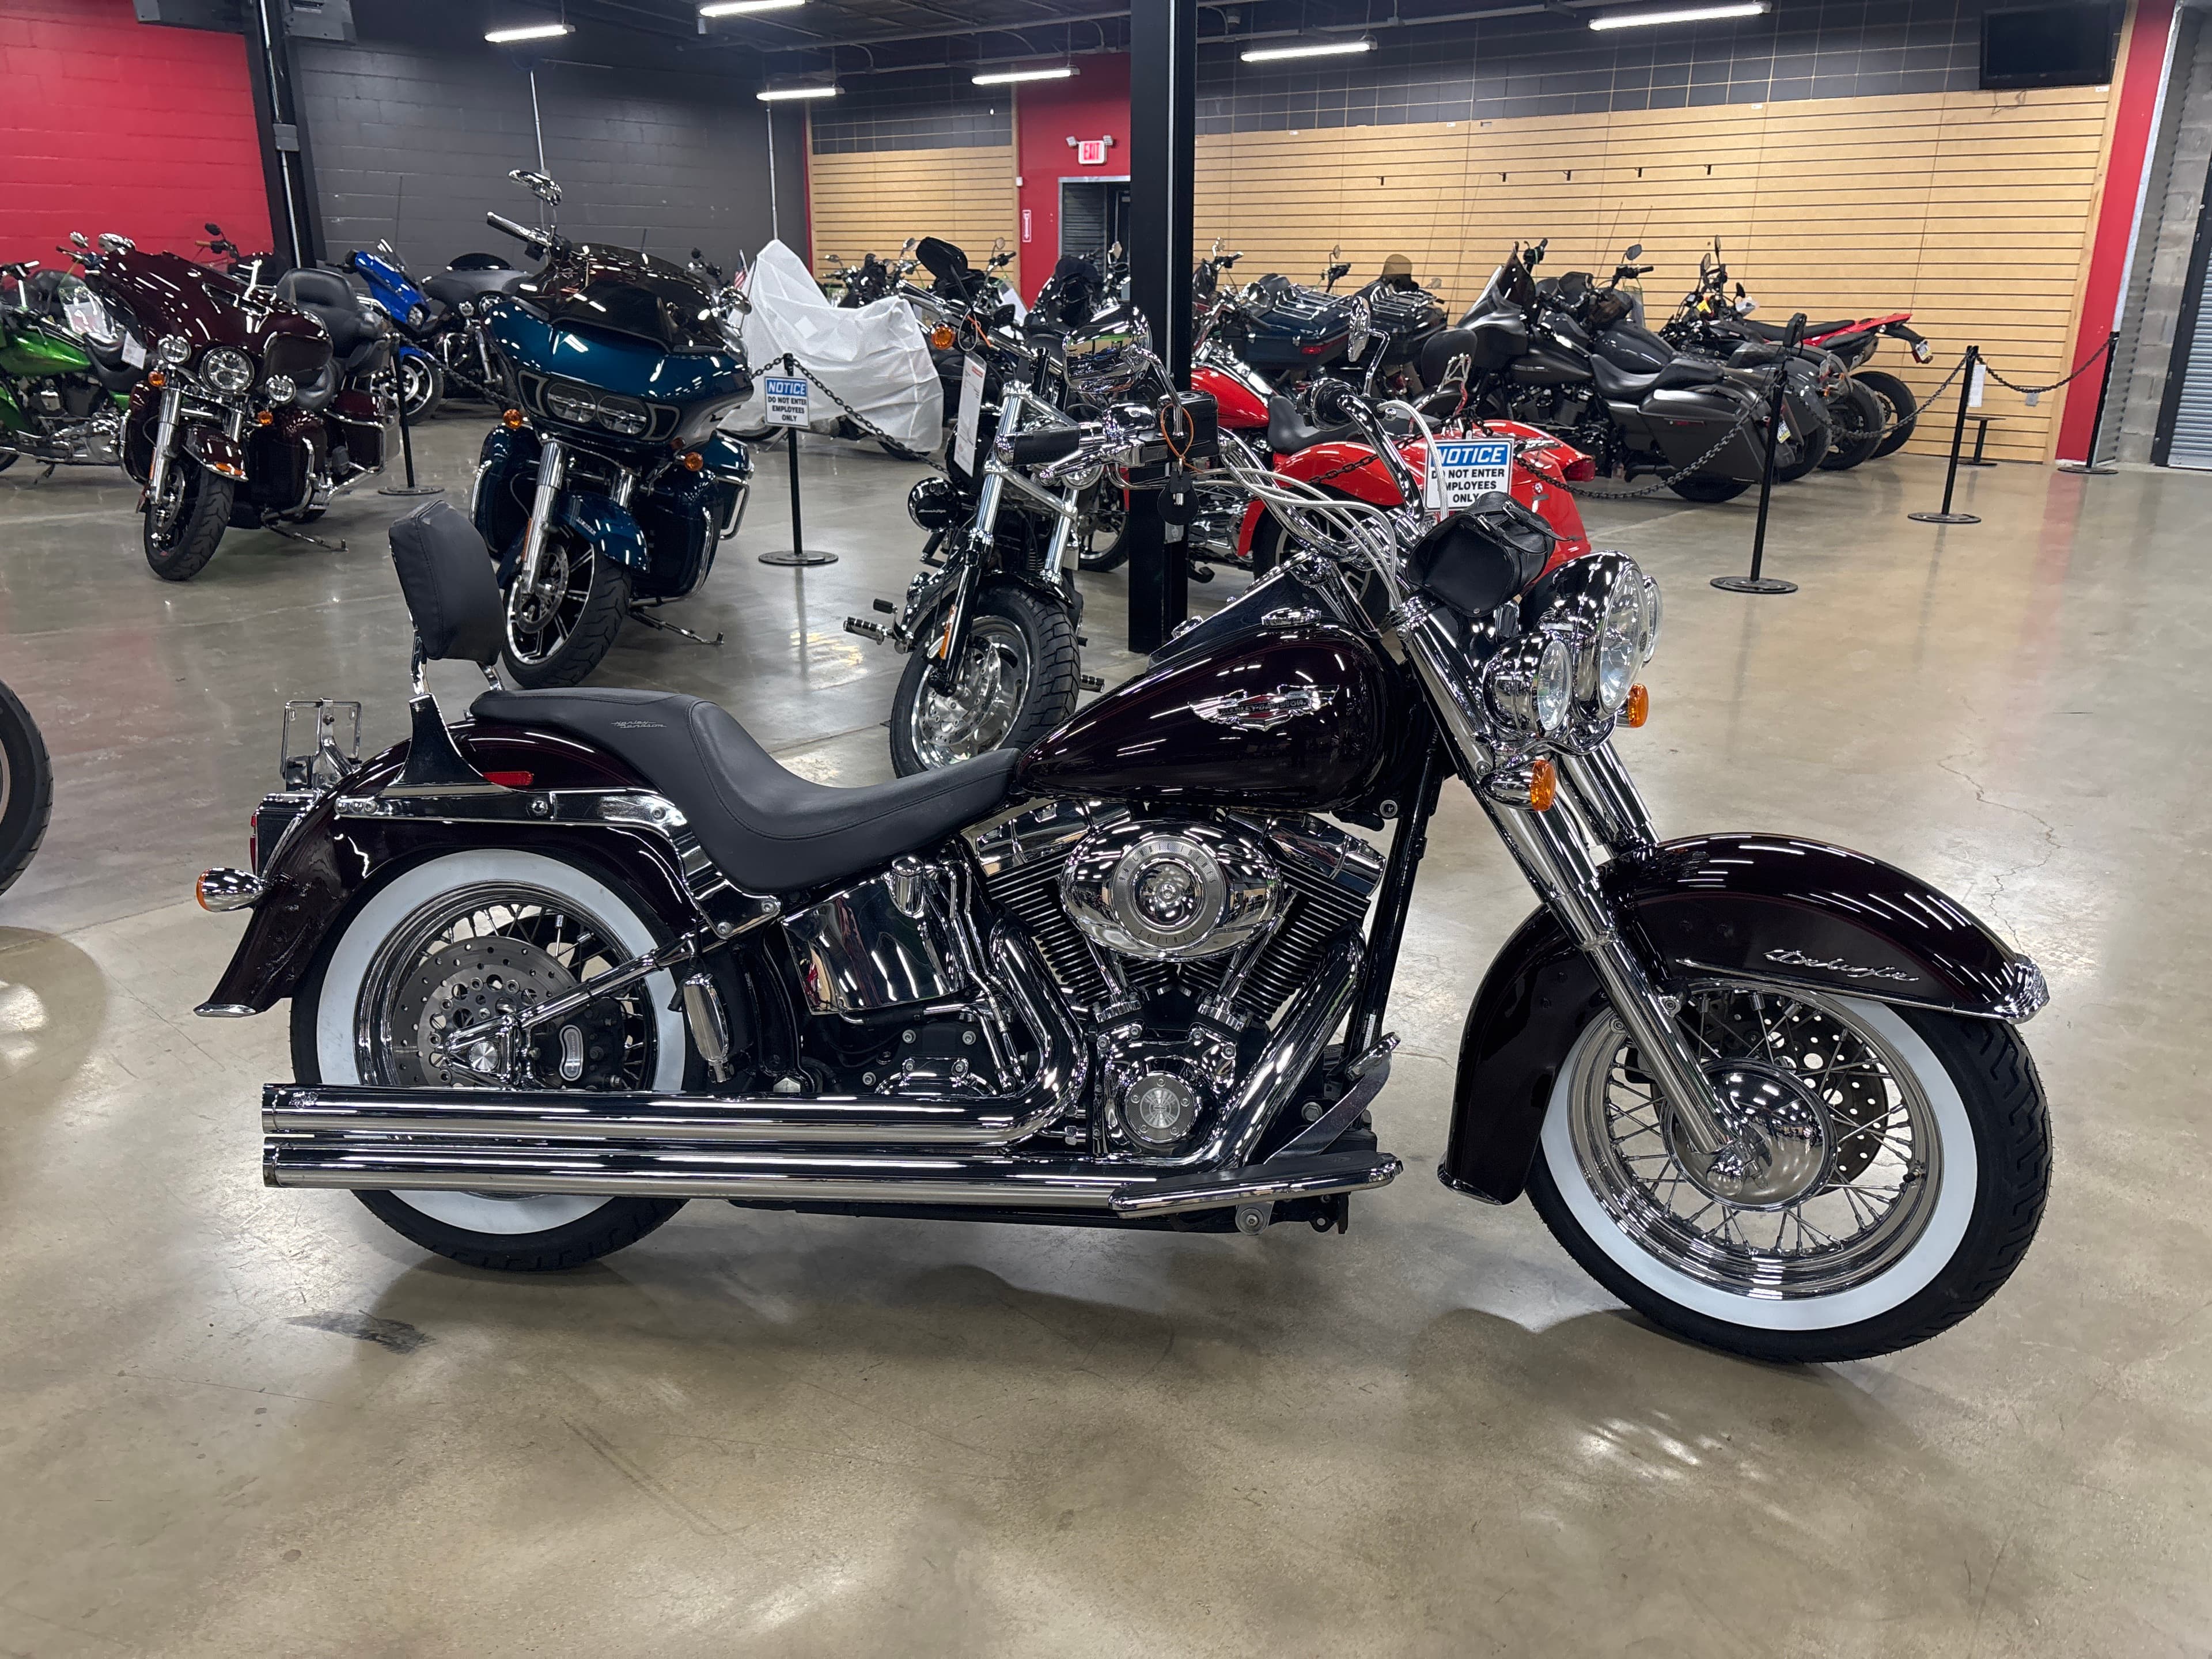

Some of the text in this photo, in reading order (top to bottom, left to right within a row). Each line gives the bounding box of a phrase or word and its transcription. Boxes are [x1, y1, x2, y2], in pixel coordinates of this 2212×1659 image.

[1084, 142, 1100, 160] EXIT
[768, 381, 806, 395] NOTICE
[778, 396, 789, 404] NOT
[791, 397, 807, 406] ENTER
[772, 405, 805, 414] EMPLOYEES
[1431, 468, 1505, 479] D NOT ENTER
[1446, 480, 1497, 491] MPLOYEES
[1452, 493, 1479, 503] ONLY
